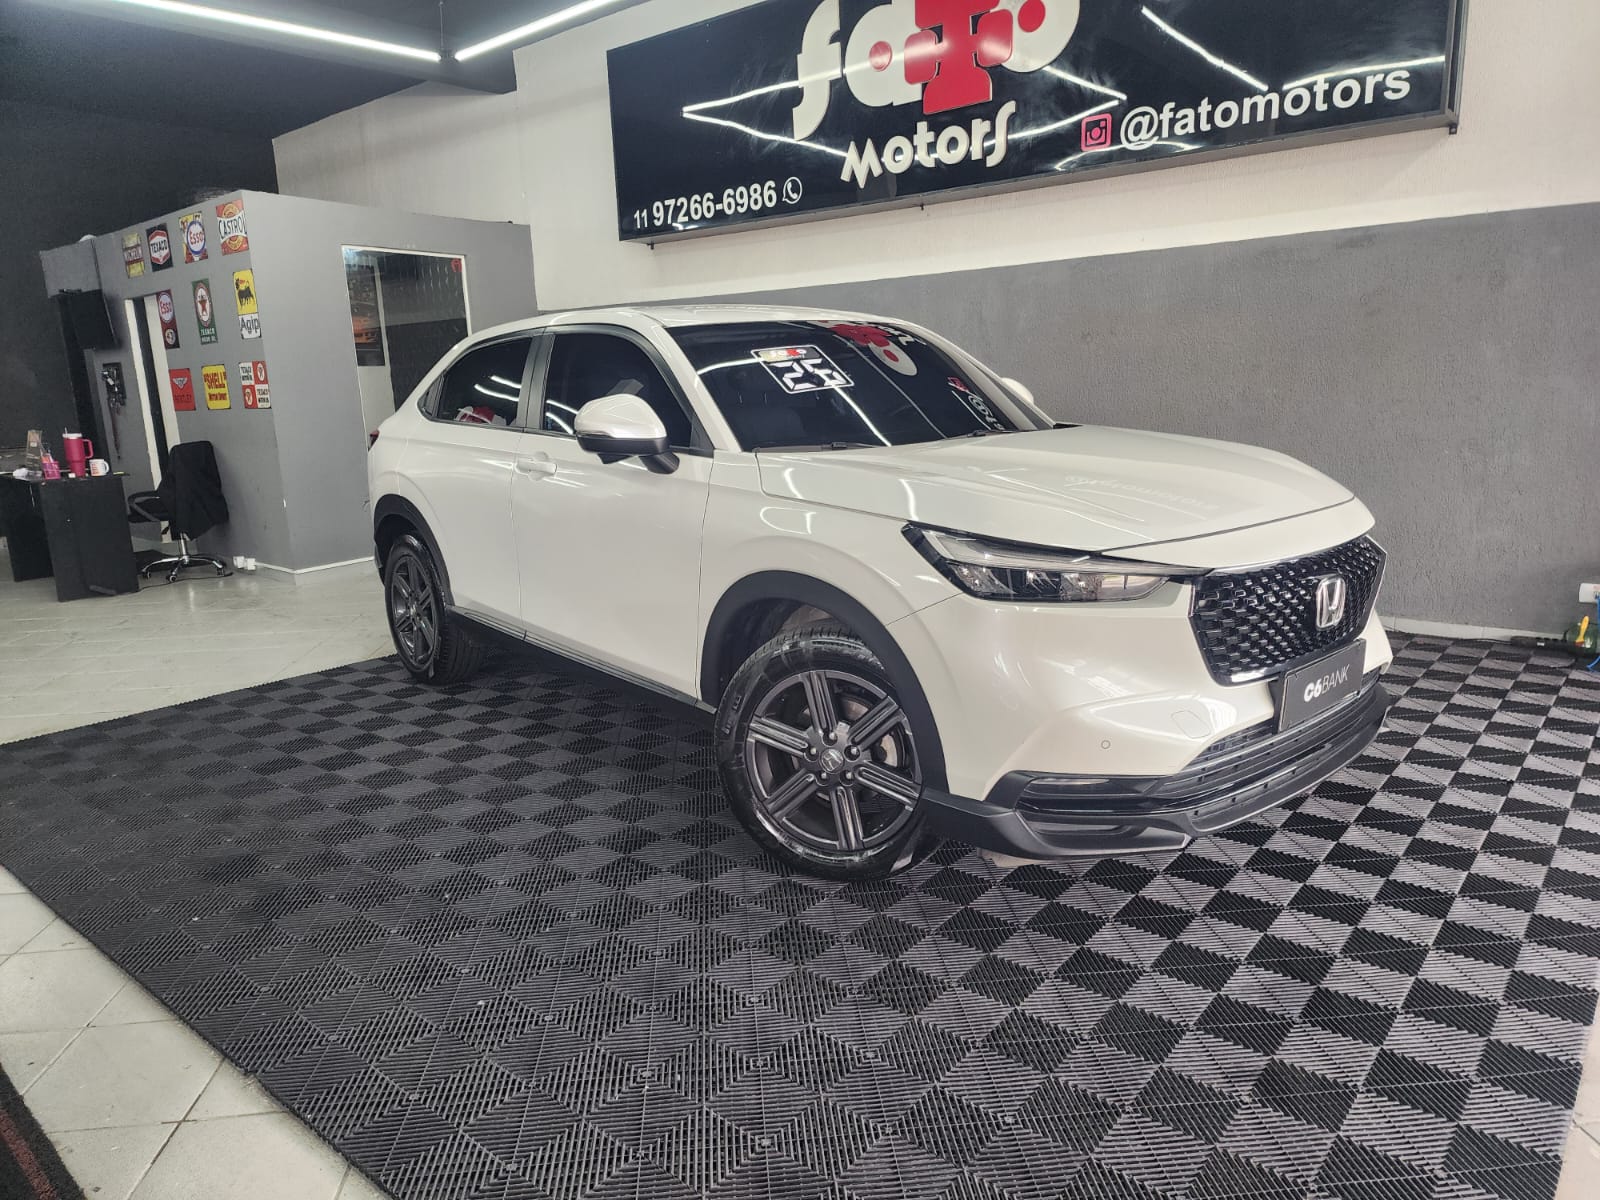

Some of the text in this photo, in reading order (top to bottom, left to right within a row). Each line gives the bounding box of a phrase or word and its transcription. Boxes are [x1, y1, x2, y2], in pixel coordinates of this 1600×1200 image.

[1119, 69, 1412, 151] @fatomotors
[840, 100, 1017, 189] Motors
[633, 180, 777, 230] 11 97266-6986
[218, 211, 248, 240] CASTROL
[150, 239, 168, 254] TEXACO
[240, 315, 260, 334] Agip
